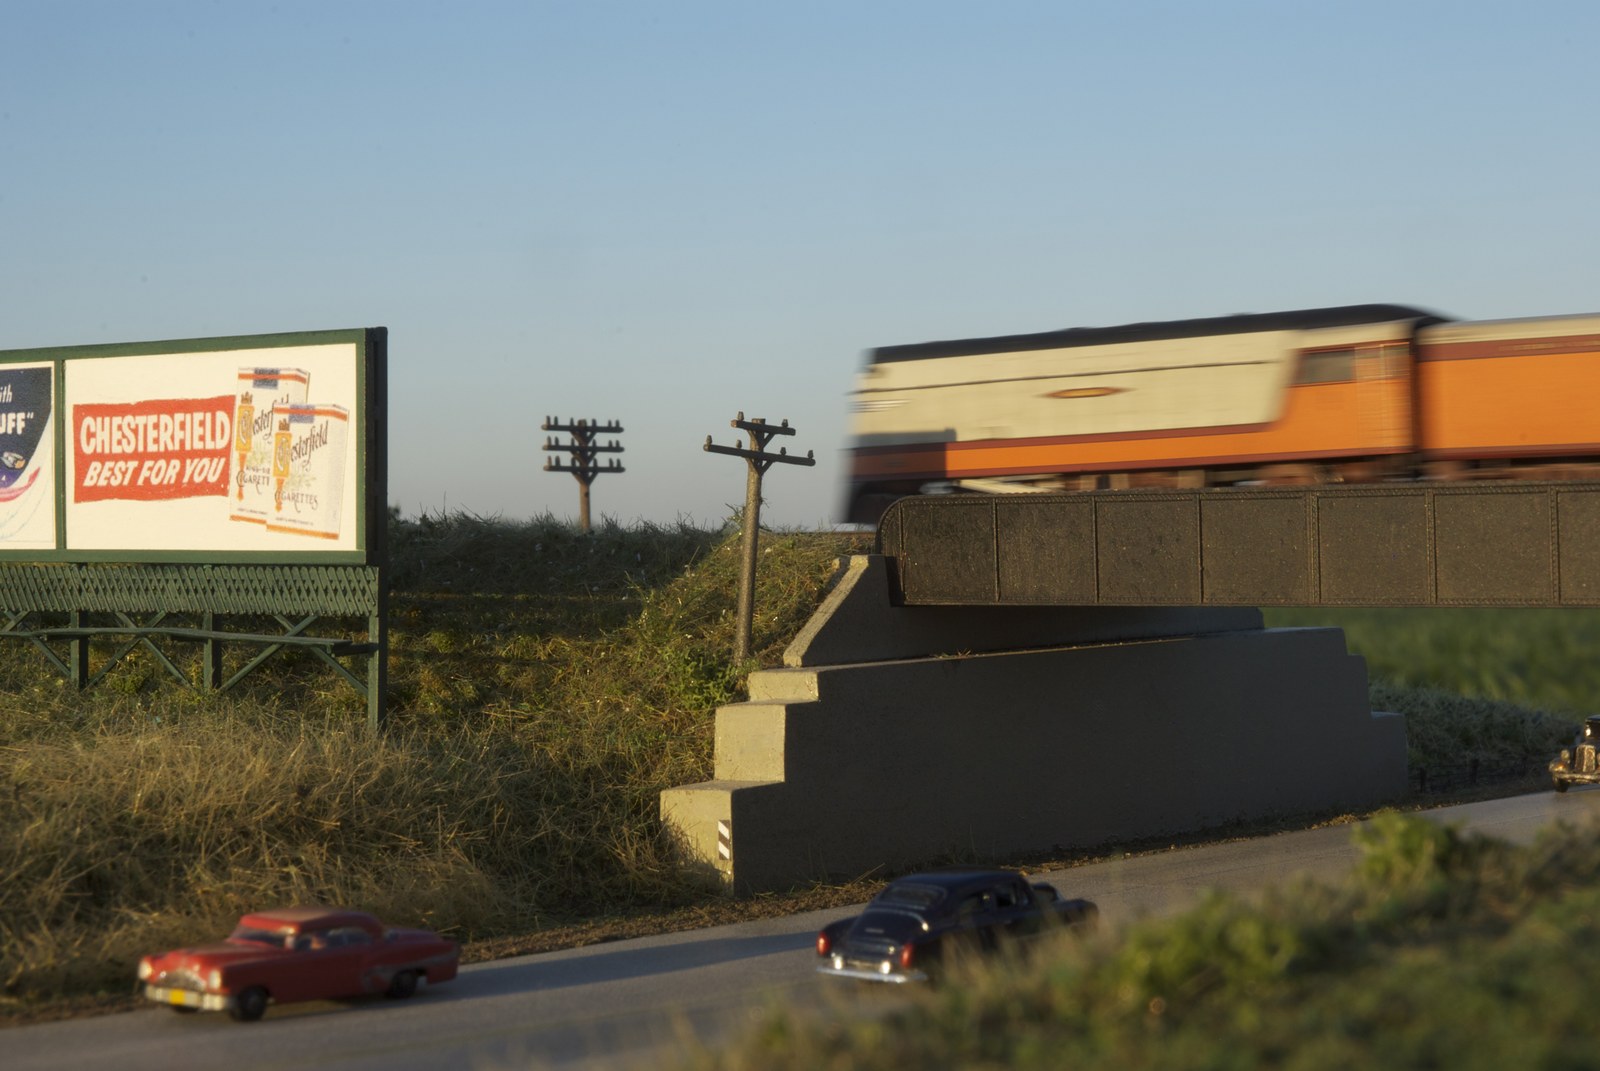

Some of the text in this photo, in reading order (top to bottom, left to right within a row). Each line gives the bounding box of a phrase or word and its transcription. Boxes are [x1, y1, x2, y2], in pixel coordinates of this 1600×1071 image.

[80, 411, 231, 455] CHESTERFIELD
[83, 457, 226, 487] BEST FOR YOU
